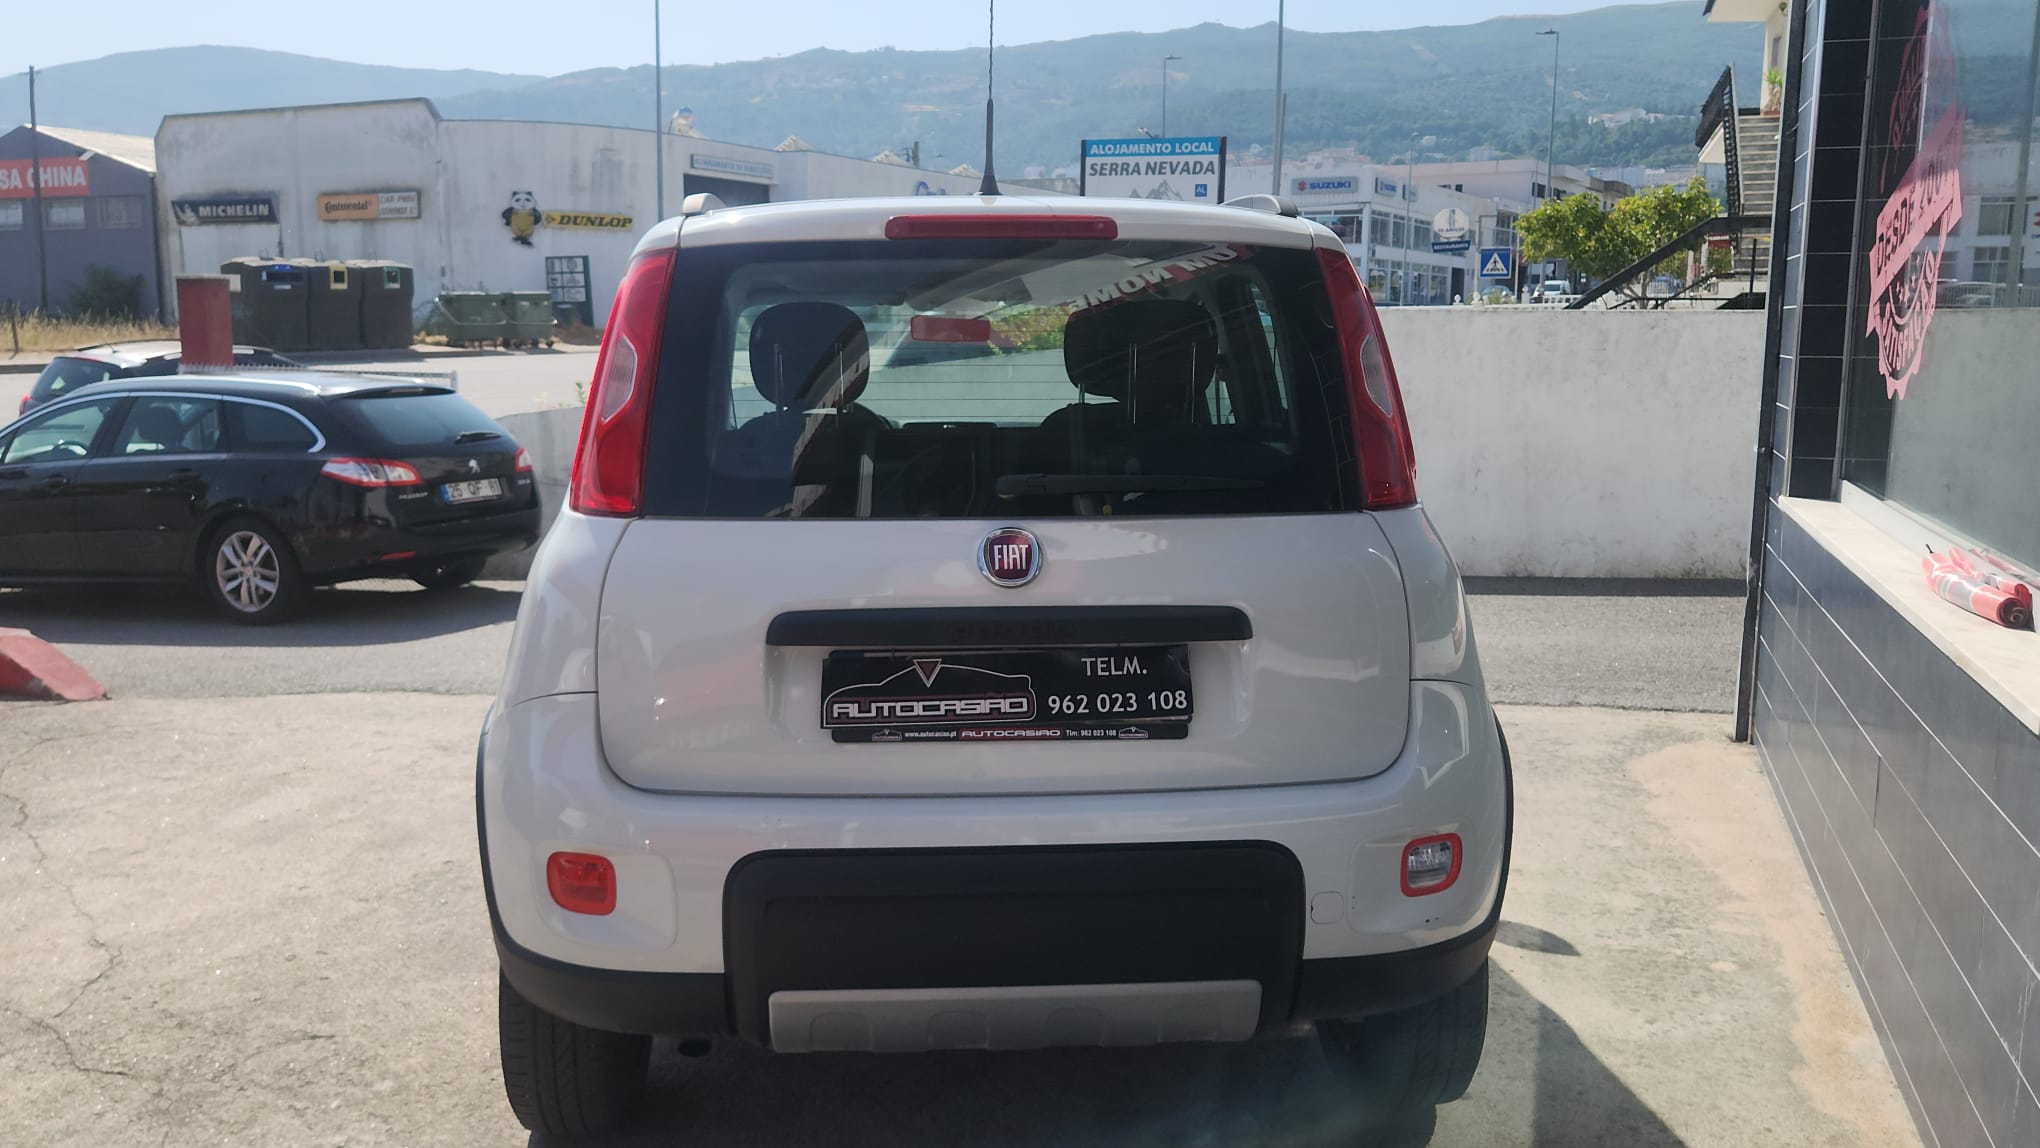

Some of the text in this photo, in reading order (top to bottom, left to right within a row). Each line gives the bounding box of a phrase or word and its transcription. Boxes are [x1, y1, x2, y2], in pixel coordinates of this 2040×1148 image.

[1090, 141, 1214, 154] ALOJAMENTO LOCAL
[1089, 160, 1215, 176] SERRA NEVADA
[27, 165, 87, 188] CHINA
[1309, 181, 1352, 190] SUZUKI
[199, 204, 269, 217] MICHELIN
[325, 200, 368, 213] Continental
[558, 215, 632, 228] DUNLOP
[1876, 184, 1916, 278] DESDE
[450, 485, 463, 498] 25
[468, 481, 483, 495] QF
[993, 544, 1028, 570] FIAT
[1081, 656, 1148, 676] TELM.
[1048, 690, 1187, 714] 962 023 108
[961, 730, 1061, 738] AUTOCASIAO
[1081, 729, 1092, 737] 962
[1093, 729, 1105, 737] 023
[1106, 729, 1117, 737] 108
